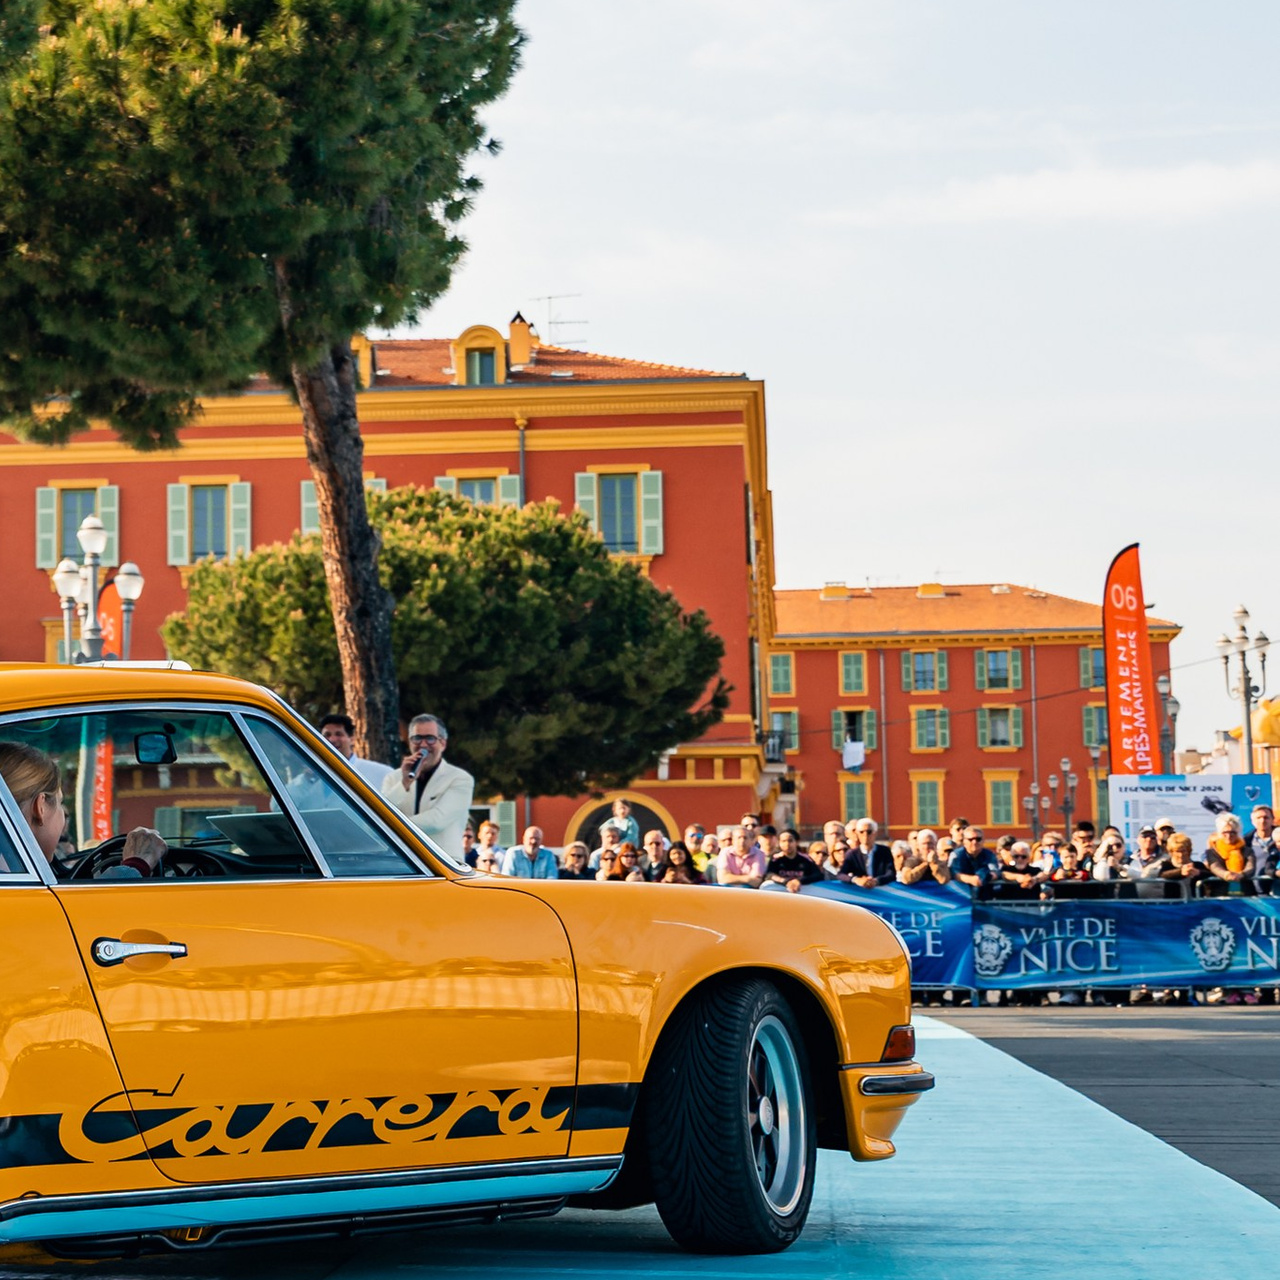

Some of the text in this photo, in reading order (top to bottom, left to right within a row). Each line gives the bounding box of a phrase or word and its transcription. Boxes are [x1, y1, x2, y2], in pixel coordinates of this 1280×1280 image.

[1110, 583, 1138, 611] 06
[1116, 629, 1134, 770] ARTEMENT
[1165, 785, 1176, 793] DE
[1082, 917, 1117, 937] DE
[1239, 916, 1280, 936] VIL
[1019, 938, 1119, 975] NICE
[58, 1072, 572, 1163] Carrera
